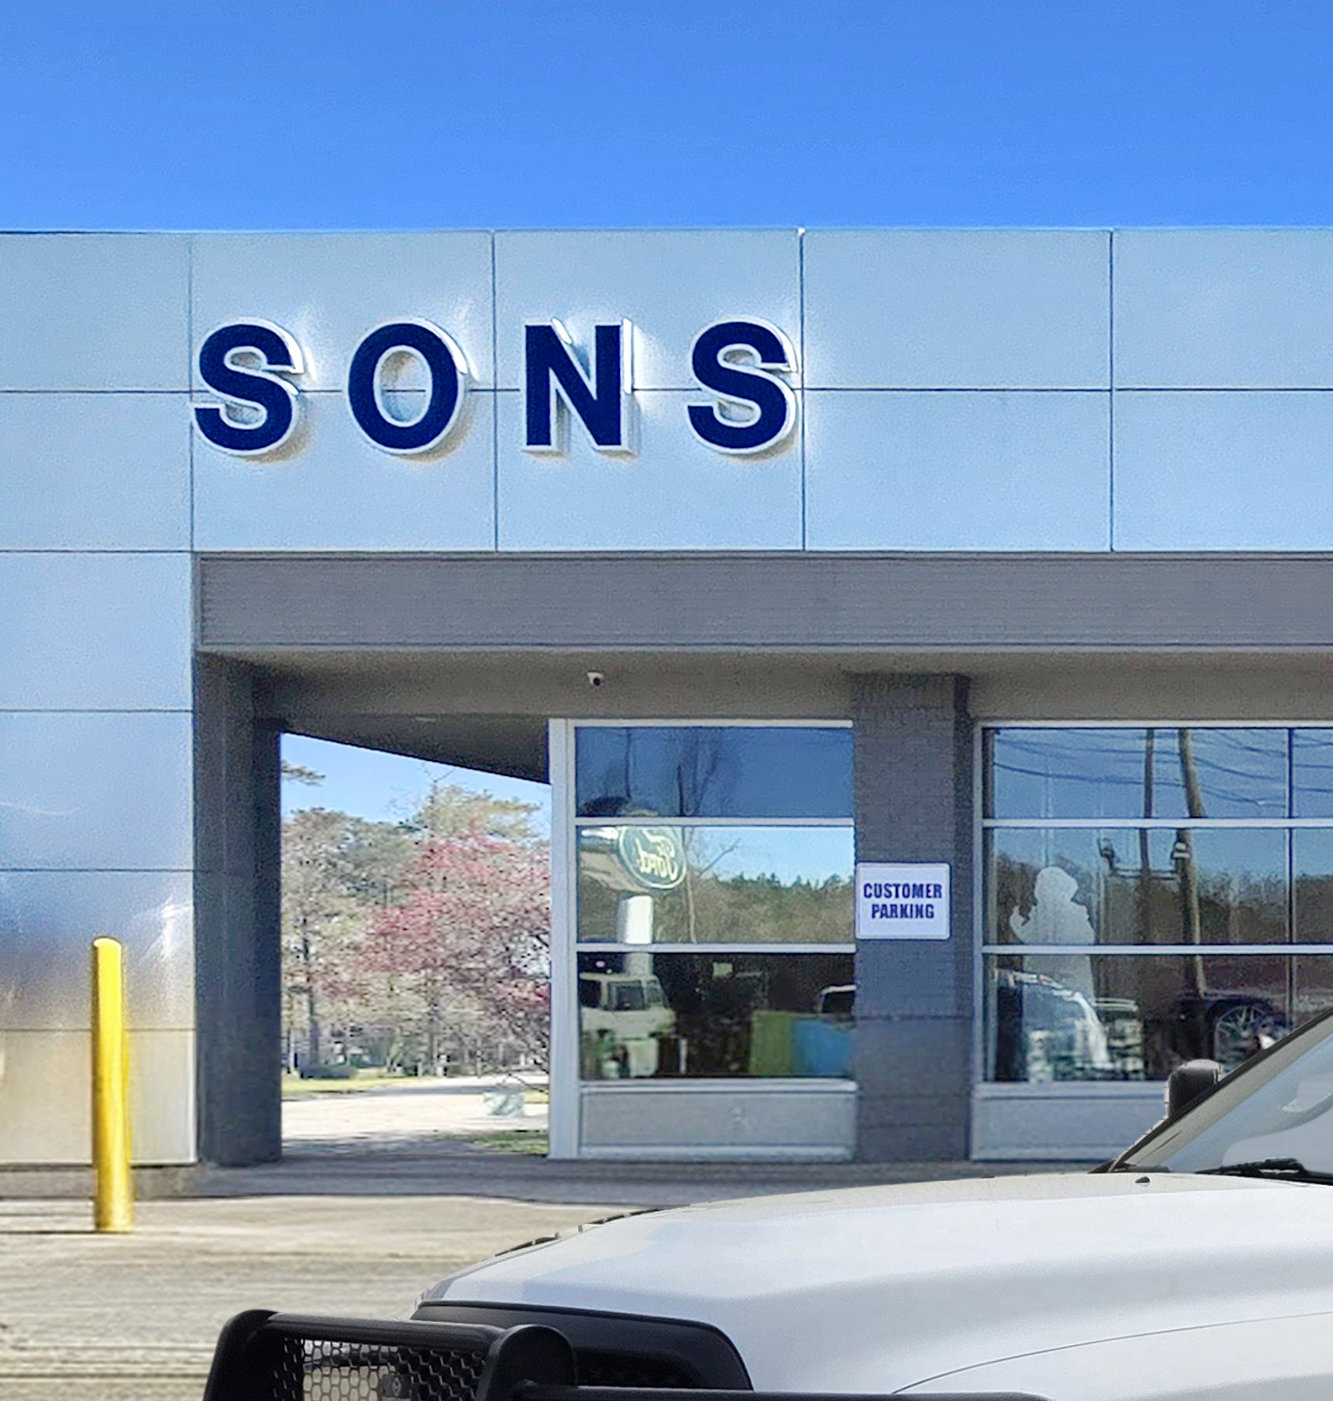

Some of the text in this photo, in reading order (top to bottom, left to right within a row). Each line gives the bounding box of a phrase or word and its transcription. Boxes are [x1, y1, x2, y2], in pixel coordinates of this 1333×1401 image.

[193, 320, 796, 452] SONS
[863, 882, 942, 899] CUSTOMER
[871, 903, 935, 919] PARKING
